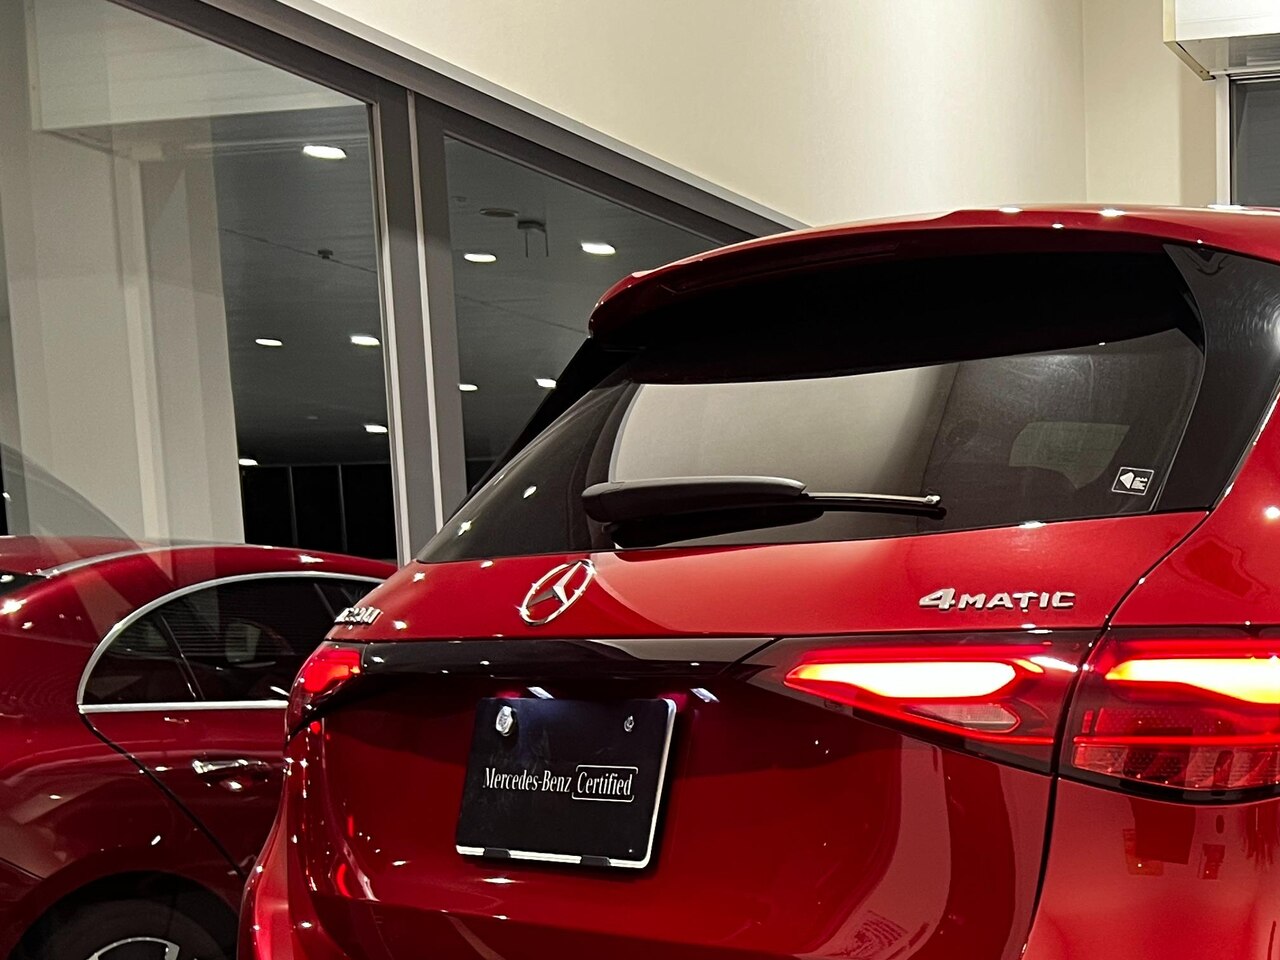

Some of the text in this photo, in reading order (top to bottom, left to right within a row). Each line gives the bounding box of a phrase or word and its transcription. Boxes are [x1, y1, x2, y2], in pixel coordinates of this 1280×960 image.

[919, 588, 1075, 609] 4MATIC
[483, 767, 633, 796] Mercedes-Benz Certified
